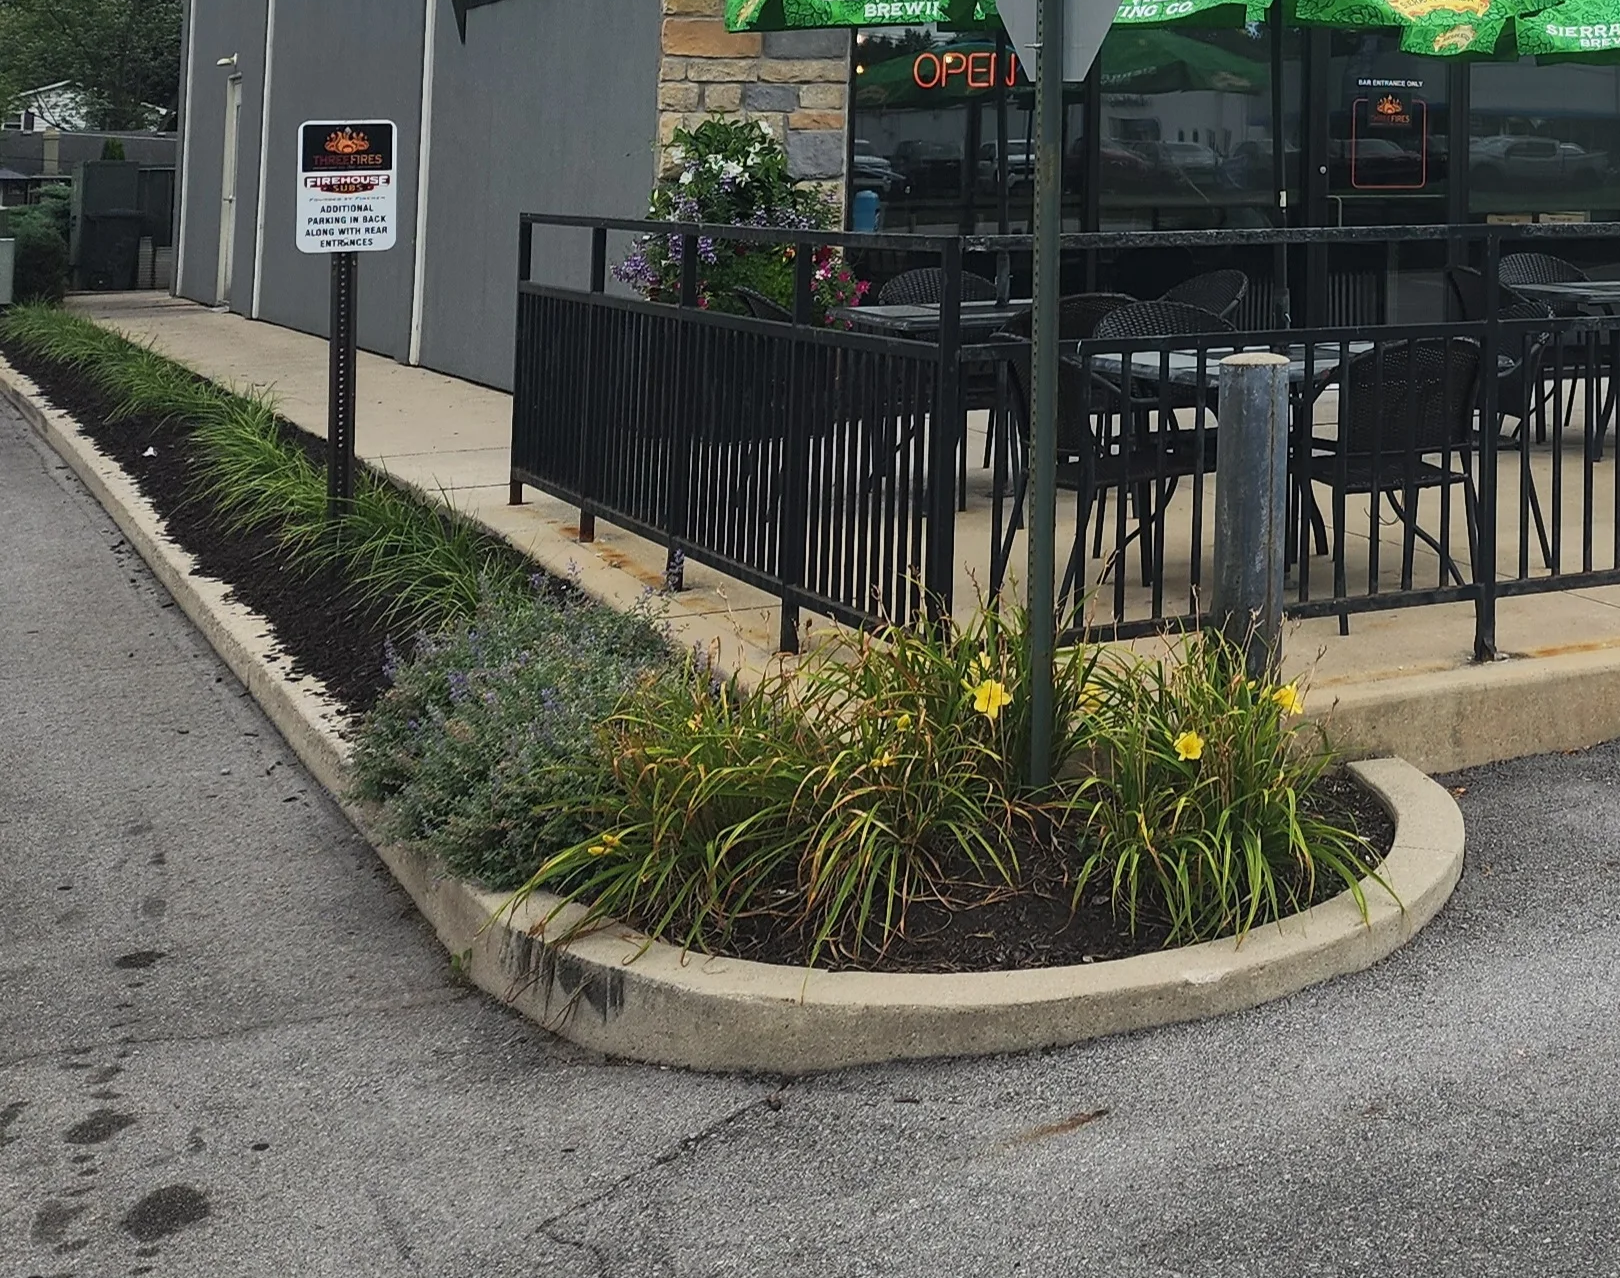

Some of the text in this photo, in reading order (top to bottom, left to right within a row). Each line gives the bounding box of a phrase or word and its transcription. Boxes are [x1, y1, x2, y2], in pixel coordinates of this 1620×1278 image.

[1373, 79, 1405, 87] ENTRANCE
[306, 175, 389, 189] FIREHOUSE
[333, 184, 364, 192] SUBS
[320, 205, 374, 213] ADDITIONAL
[308, 215, 387, 225] PARKING IN BACK
[305, 226, 388, 237] ALONG WITH REAR
[320, 238, 374, 248] ENTRANCES
